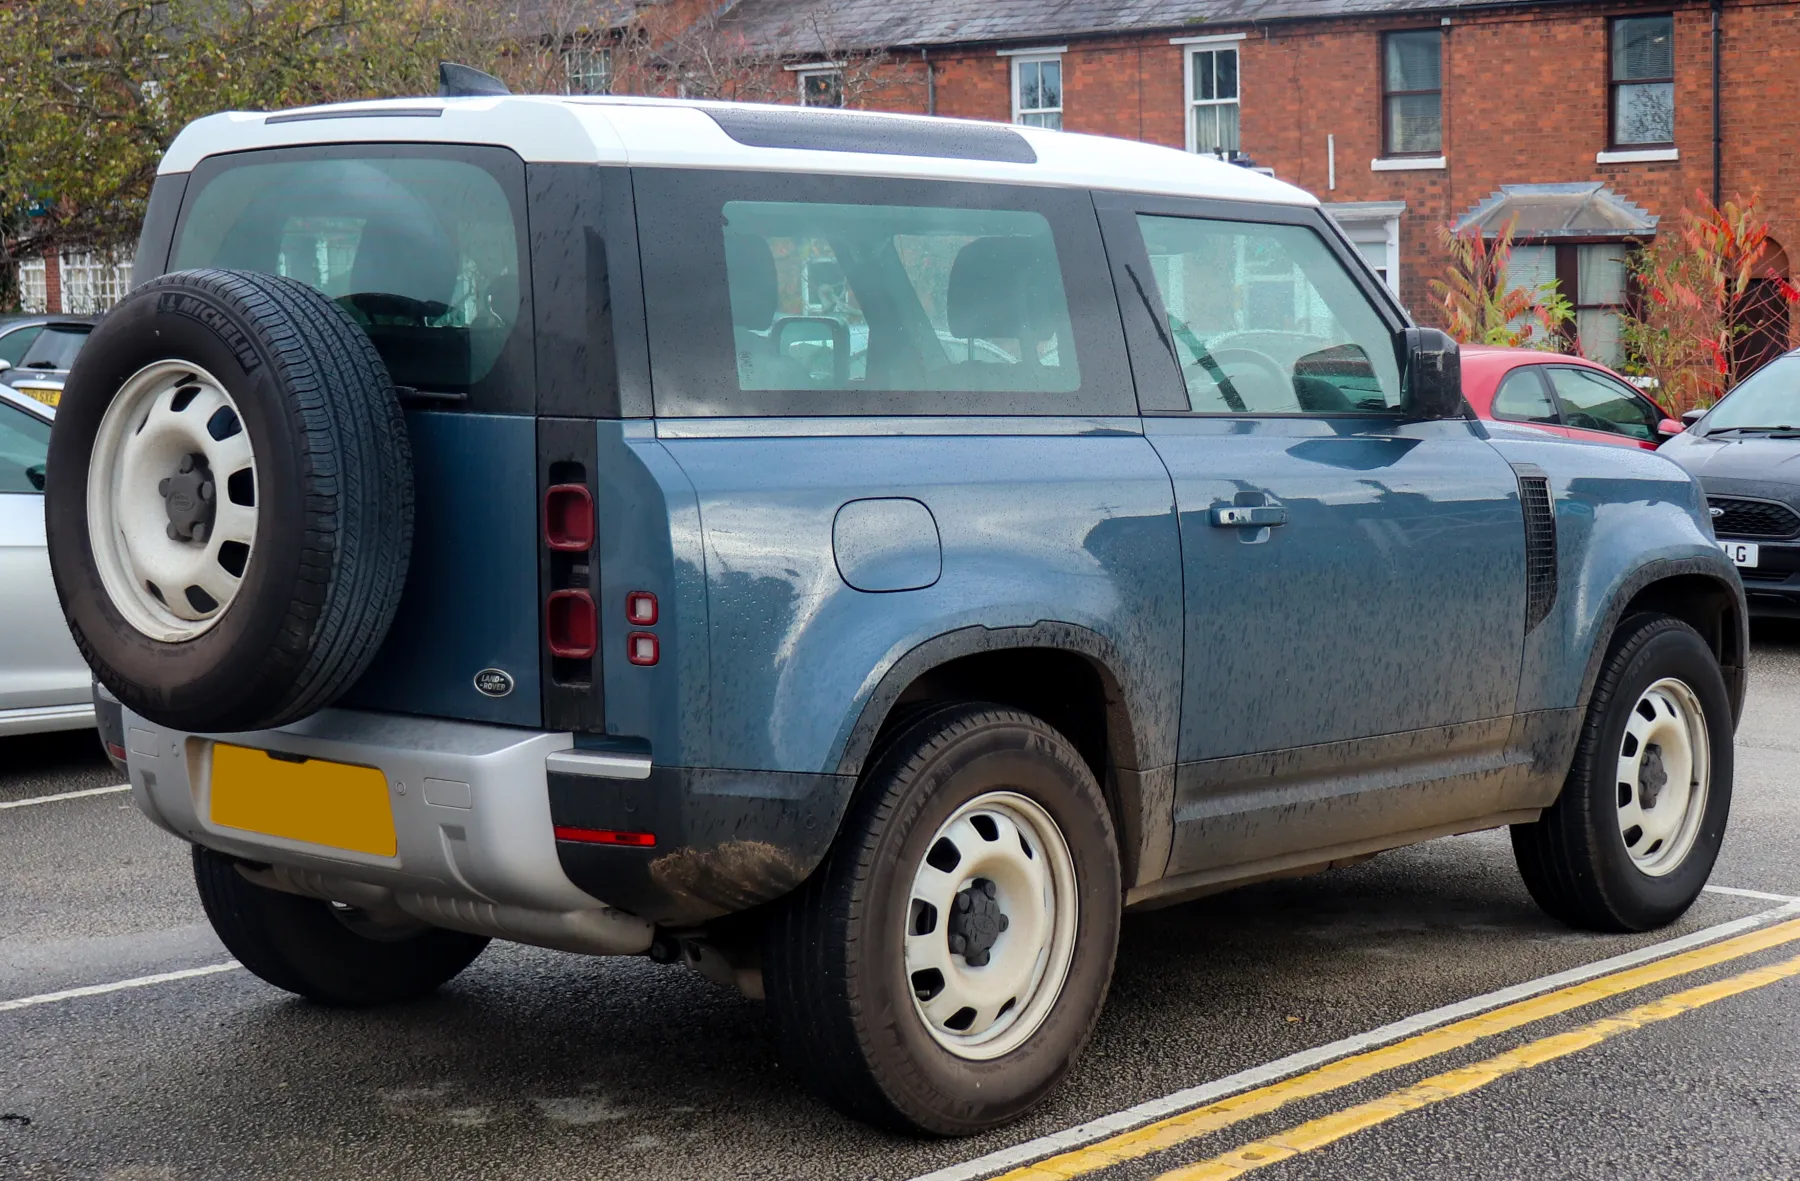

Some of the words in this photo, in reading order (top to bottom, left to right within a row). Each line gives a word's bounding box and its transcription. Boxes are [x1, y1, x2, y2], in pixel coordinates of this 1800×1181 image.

[177, 296, 260, 368] MICHELIN
[481, 675, 500, 683] LAND
[483, 683, 506, 691] ROVER
